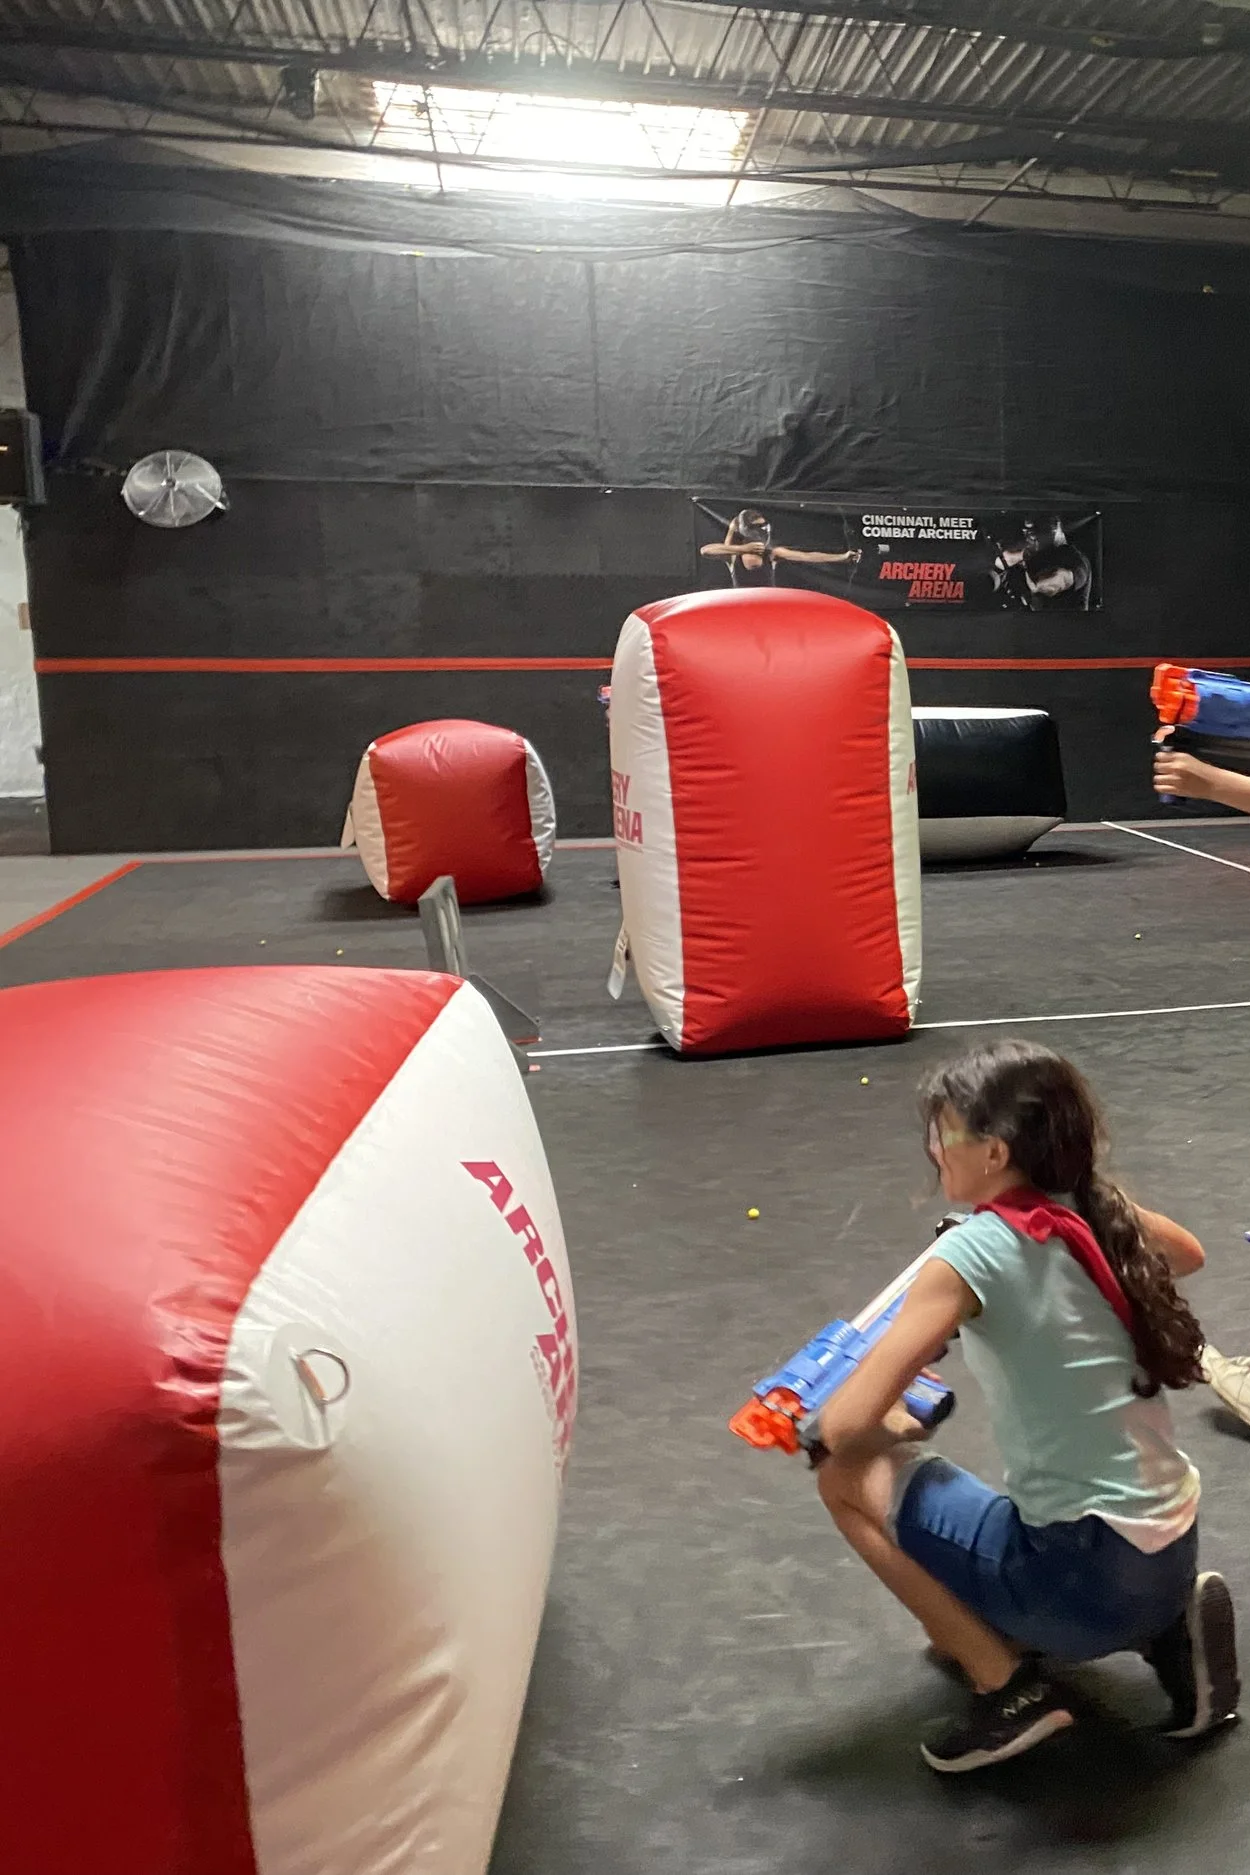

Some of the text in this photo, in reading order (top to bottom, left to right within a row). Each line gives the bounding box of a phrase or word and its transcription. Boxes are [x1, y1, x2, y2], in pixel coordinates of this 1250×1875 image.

[861, 514, 974, 529] CINCINNATI, MEET
[861, 526, 978, 540] COMBAT ARCHERY
[879, 561, 956, 580] ARCHERY
[908, 581, 965, 599] ARENA
